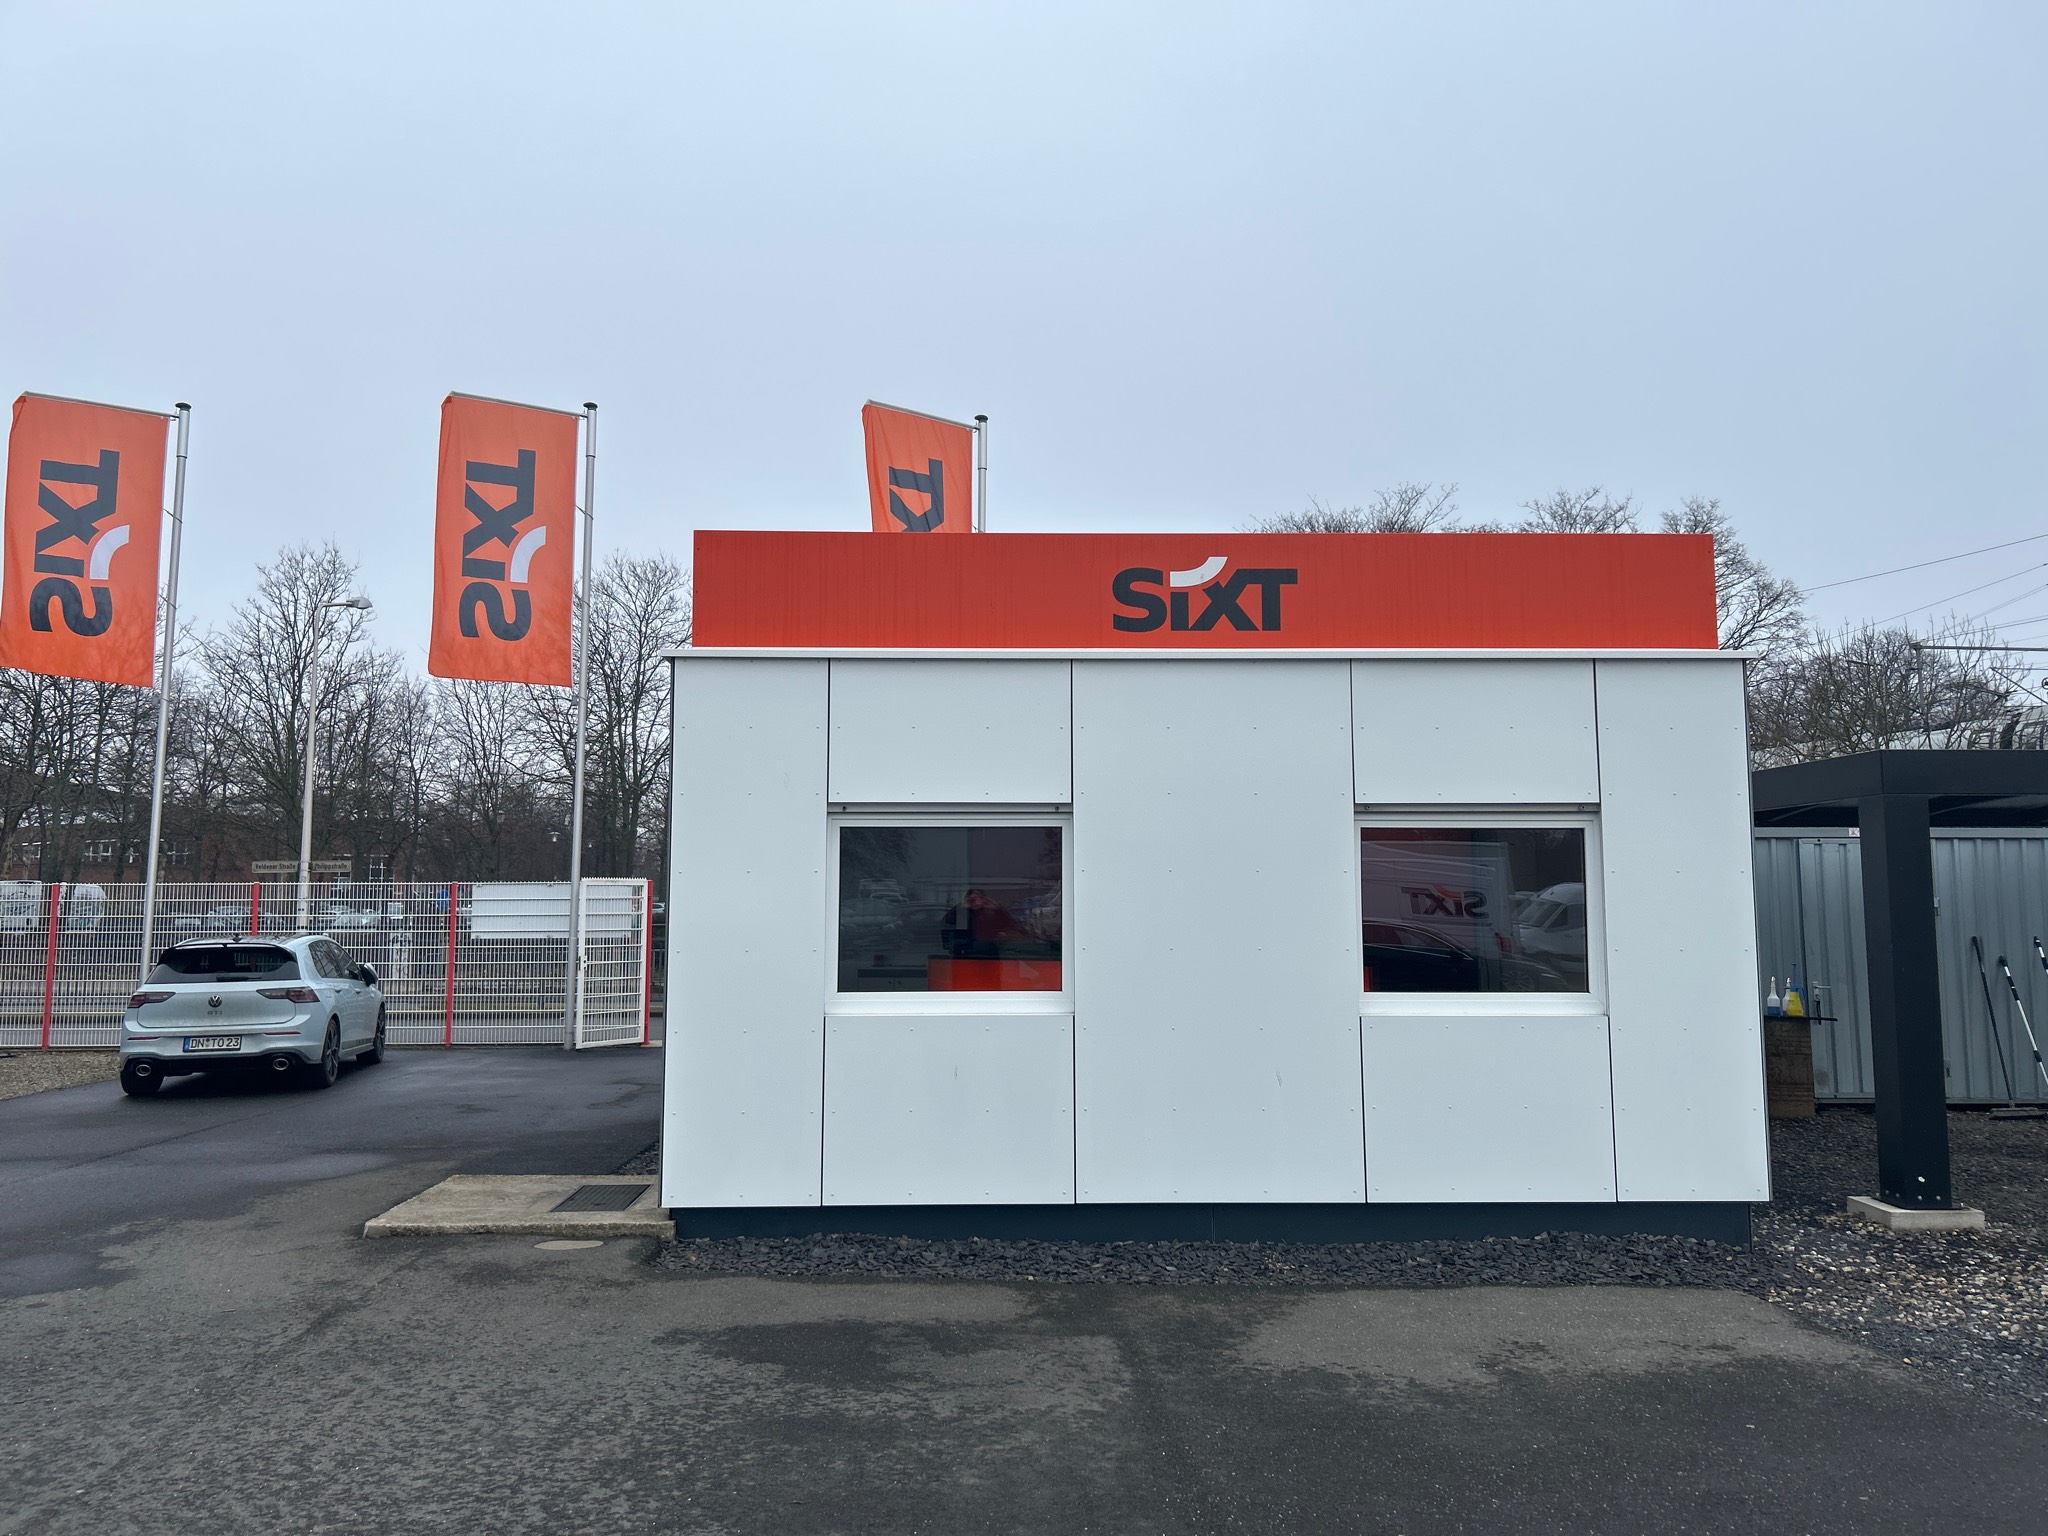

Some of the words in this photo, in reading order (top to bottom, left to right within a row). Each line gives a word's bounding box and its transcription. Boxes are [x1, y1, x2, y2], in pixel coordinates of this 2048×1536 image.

[190, 1038, 205, 1049] DN
[211, 1039, 225, 1048] TO
[226, 1037, 240, 1047] 23
